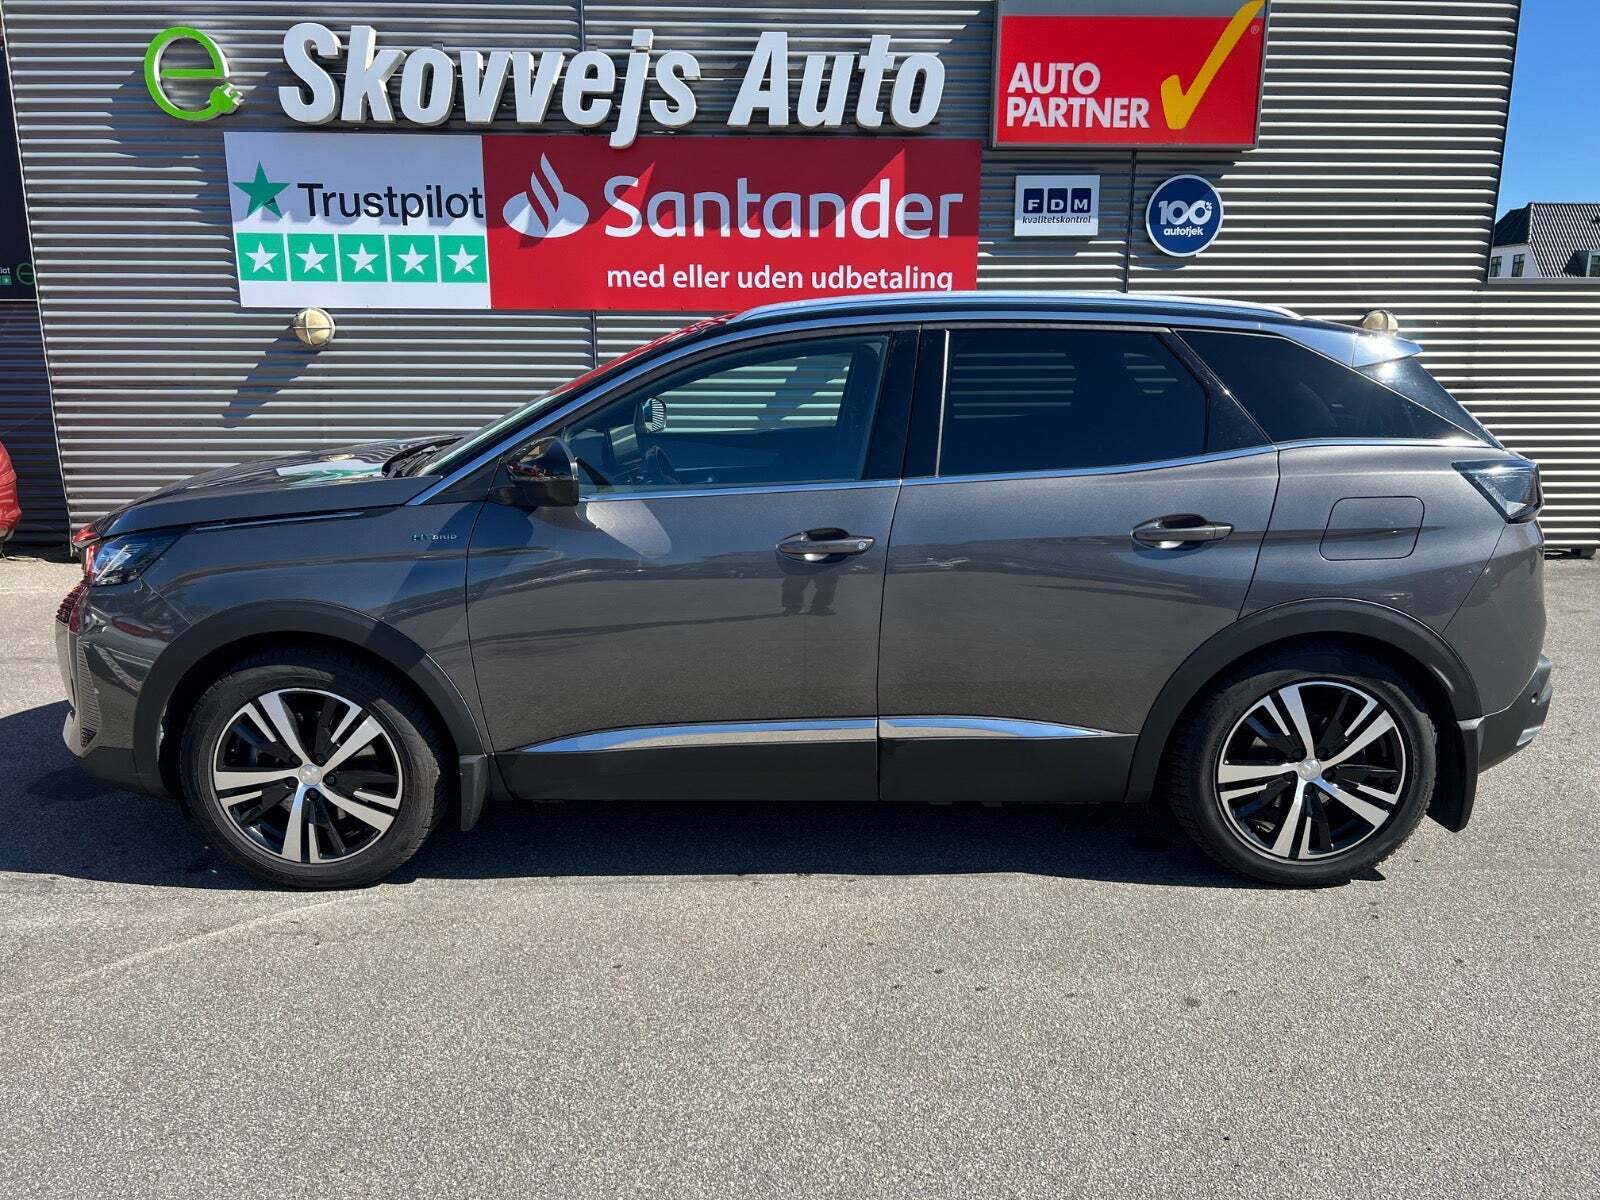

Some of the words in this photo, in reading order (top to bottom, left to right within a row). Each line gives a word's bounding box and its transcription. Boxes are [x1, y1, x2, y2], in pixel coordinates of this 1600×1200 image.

[279, 22, 701, 150] Skovvejs
[727, 31, 946, 130] Auto
[1007, 62, 1101, 94] AUTO
[1006, 97, 1150, 129] PARTNER
[297, 183, 484, 226] Trustpilot
[604, 175, 964, 240] Santander
[1022, 215, 1092, 224] kvalitetskontrol
[1027, 199, 1088, 211] FDM
[1163, 227, 1204, 237] autotjek
[606, 263, 663, 289] med
[672, 264, 730, 289] eller
[737, 266, 802, 290] uden
[811, 266, 953, 292] udbetaling
